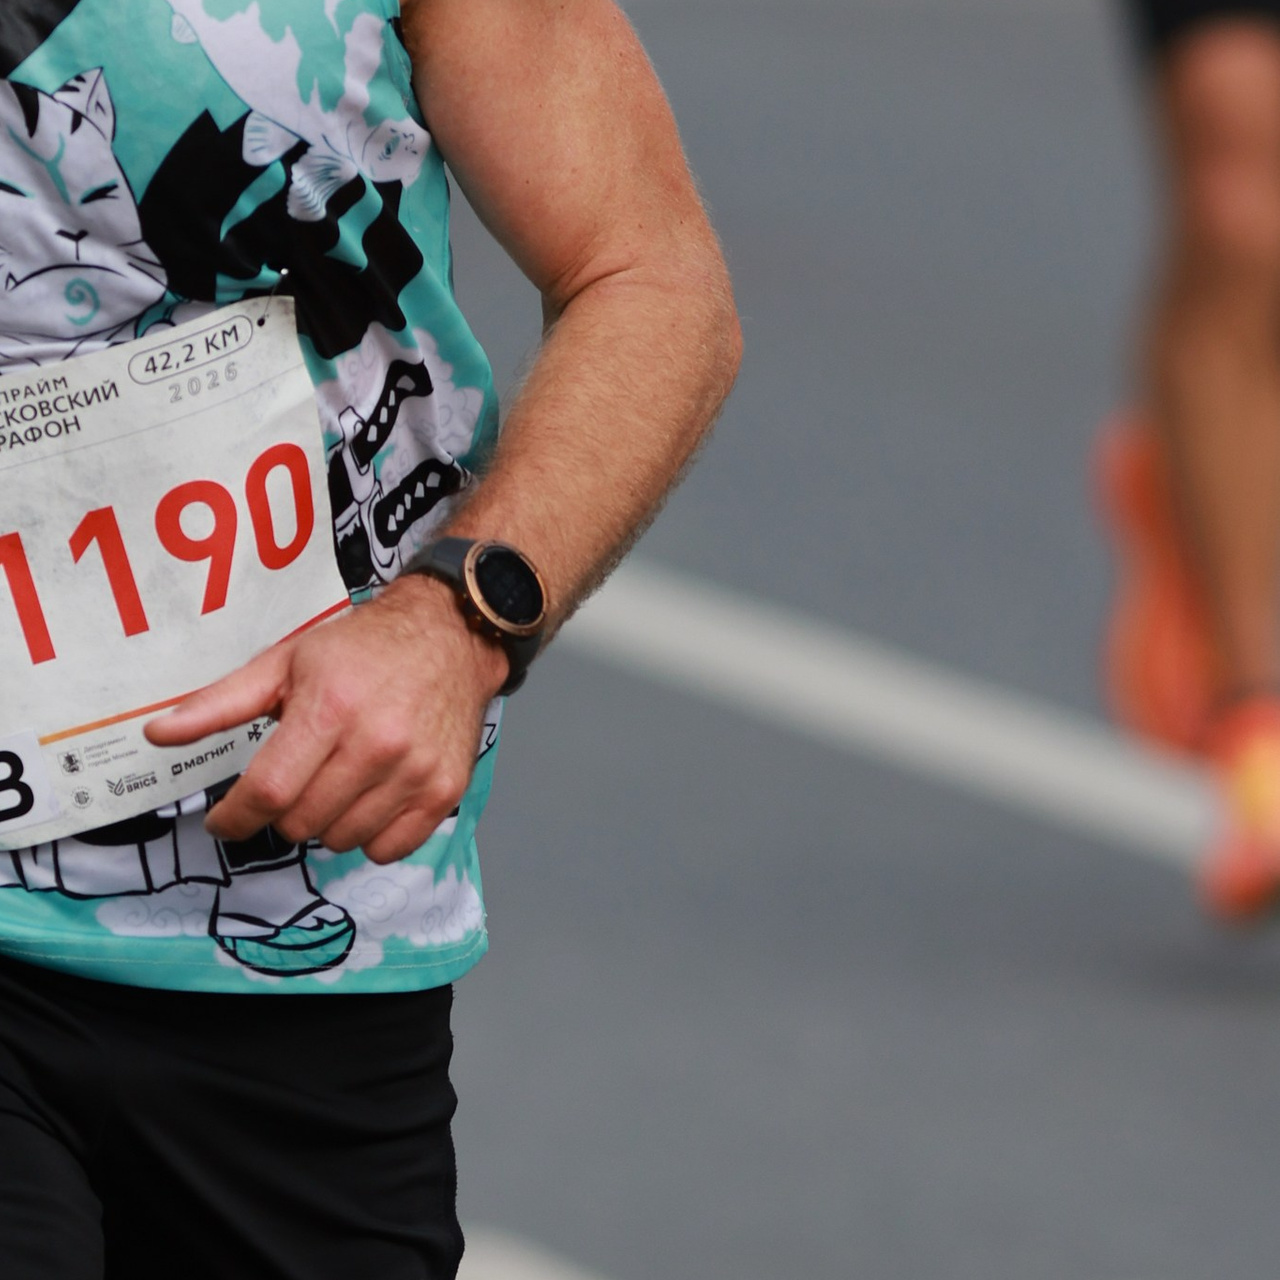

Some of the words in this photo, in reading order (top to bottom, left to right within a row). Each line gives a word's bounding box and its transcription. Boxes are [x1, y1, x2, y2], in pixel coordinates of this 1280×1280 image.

[144, 343, 196, 374] 42,2
[204, 324, 239, 355] КМ
[126, 776, 158, 794] BRICS
